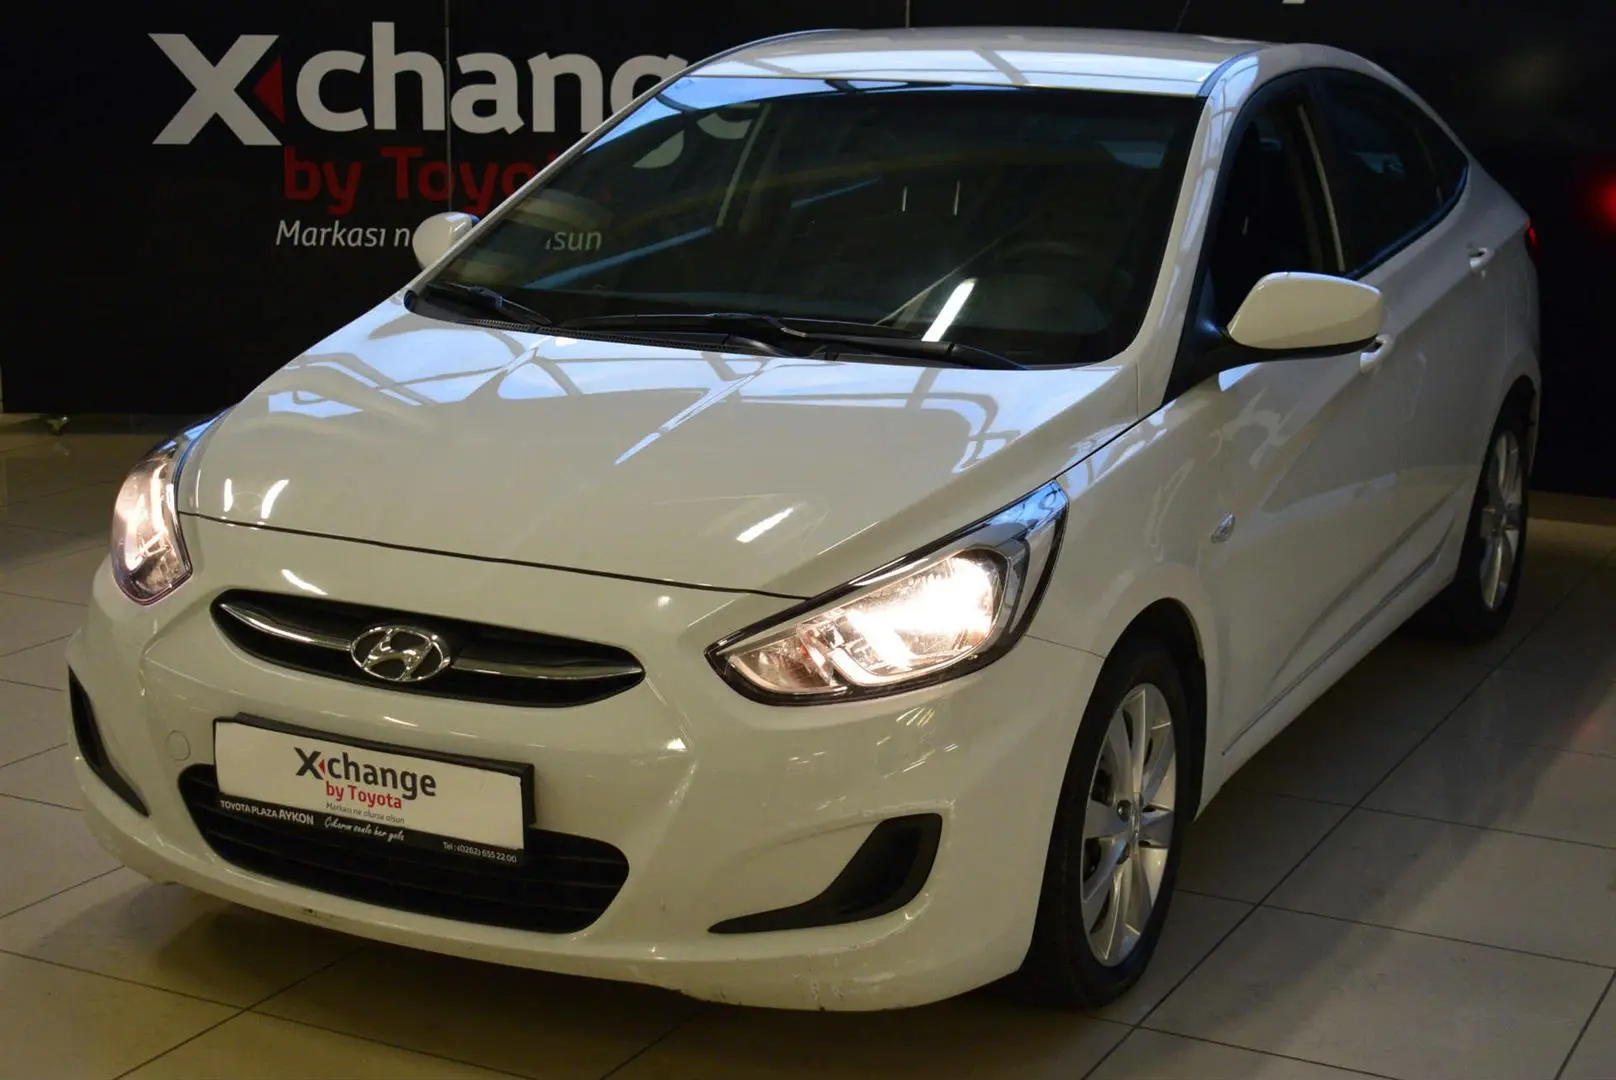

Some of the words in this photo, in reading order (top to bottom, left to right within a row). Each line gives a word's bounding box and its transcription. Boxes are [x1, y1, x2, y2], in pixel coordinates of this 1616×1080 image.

[284, 146, 363, 215] by
[381, 147, 560, 217] Toyo
[275, 220, 387, 248] Markası
[294, 747, 436, 800] Xchange
[326, 780, 344, 801] by
[348, 785, 402, 809] Toyota
[220, 800, 251, 812] TOYOTA
[251, 806, 277, 818] PLAZA
[279, 809, 314, 825] AYKON
